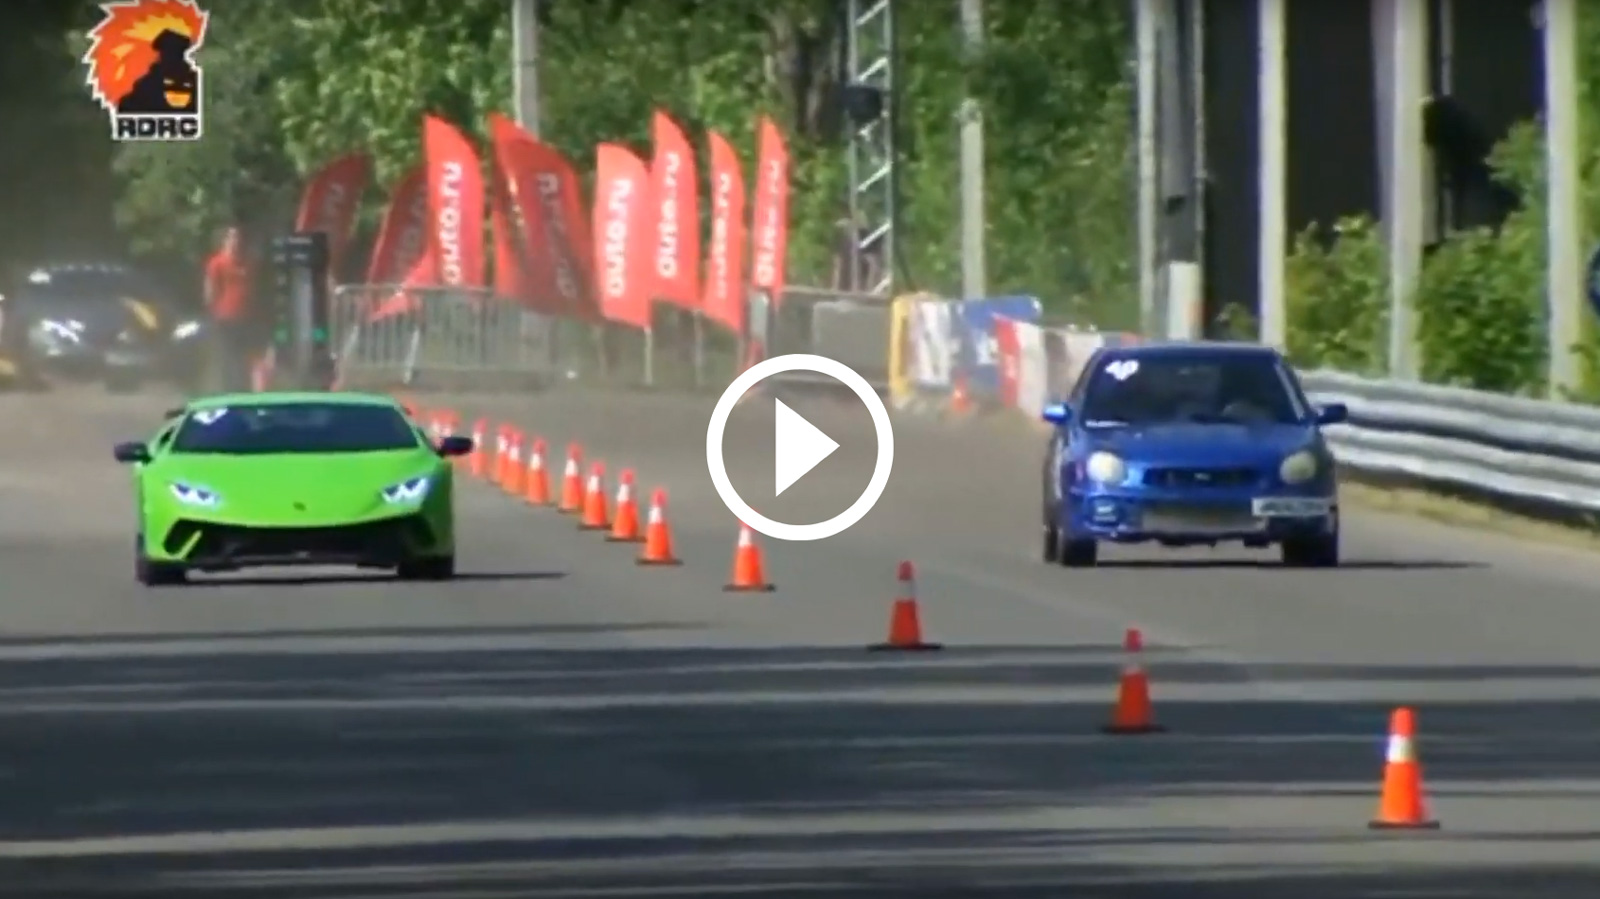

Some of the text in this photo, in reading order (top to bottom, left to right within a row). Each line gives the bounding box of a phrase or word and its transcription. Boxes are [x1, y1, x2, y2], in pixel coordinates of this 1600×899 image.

[439, 161, 463, 285] auto.ru
[605, 178, 633, 298] auto.ru
[657, 152, 680, 279] auto.ru
